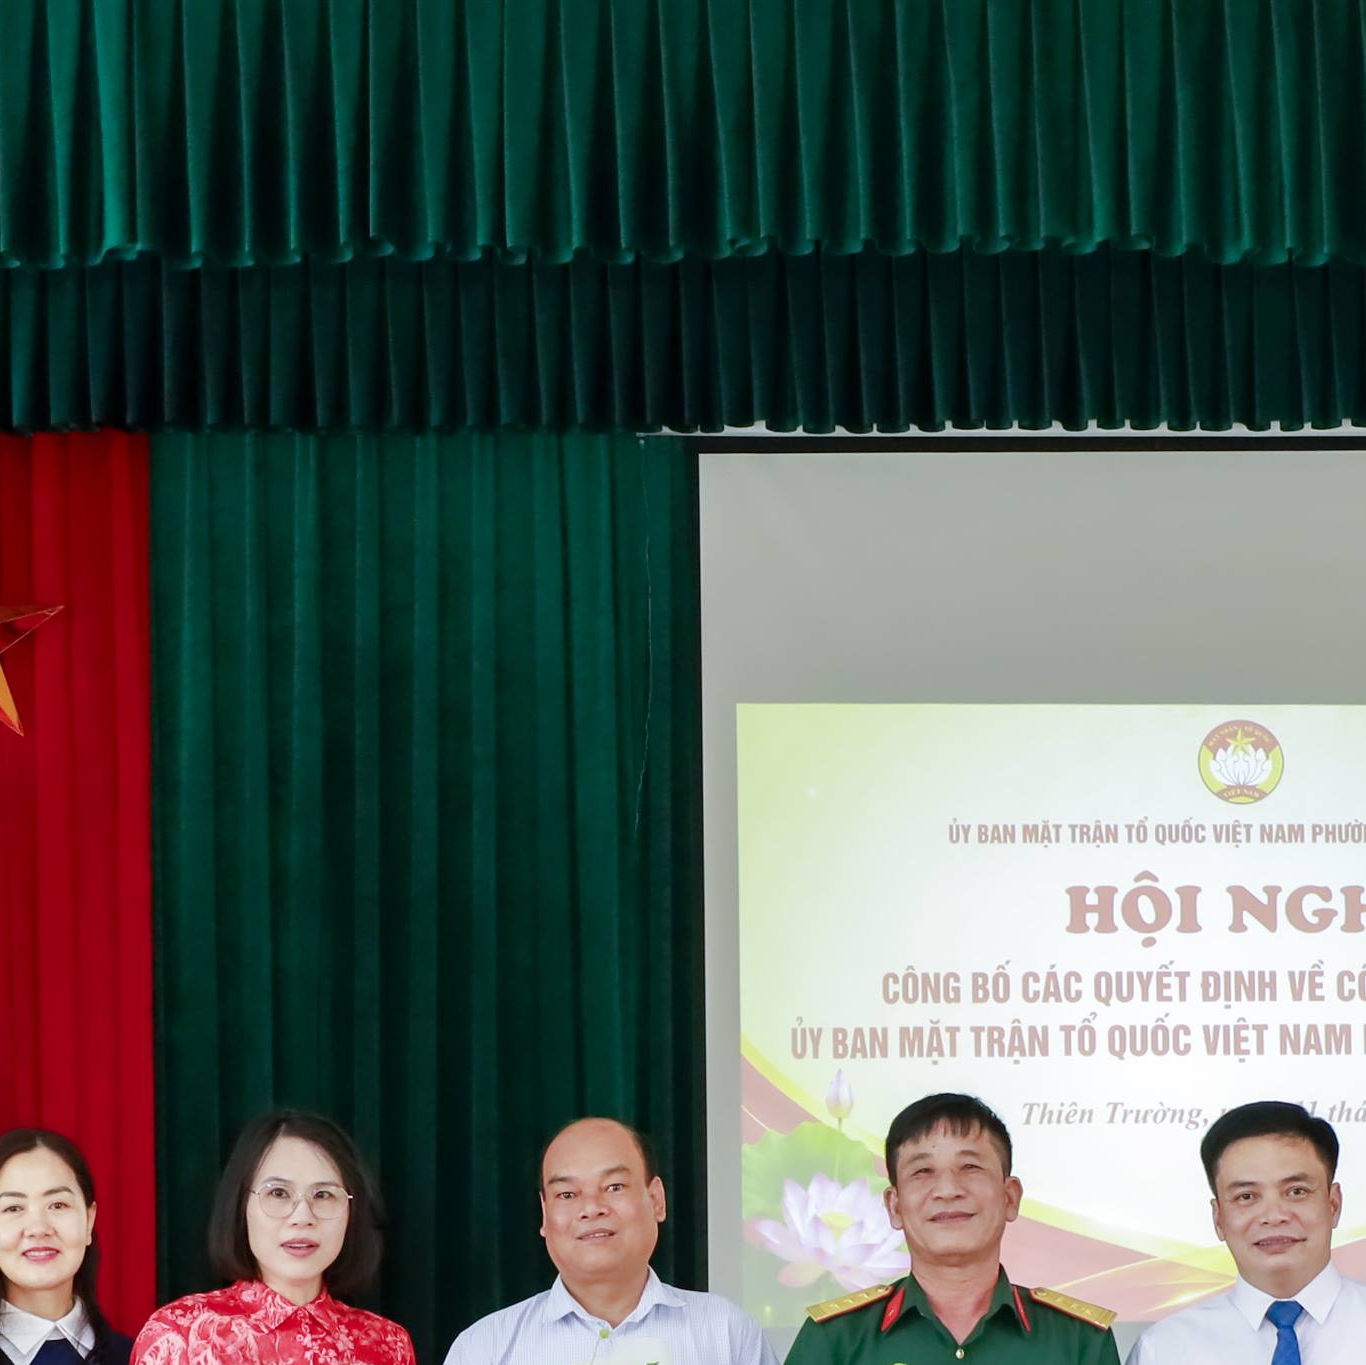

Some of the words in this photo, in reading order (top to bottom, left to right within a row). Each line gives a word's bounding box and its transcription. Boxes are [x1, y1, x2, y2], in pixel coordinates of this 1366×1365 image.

[947, 817, 972, 845] ỦY
[977, 822, 1017, 845] BAN
[1022, 819, 1063, 848] MẶT
[1068, 819, 1119, 848] TRẬN
[1125, 815, 1149, 845] TỔ
[1154, 816, 1207, 846] QUỐC
[1212, 818, 1254, 848] VIỆT
[1259, 822, 1305, 844] NAM
[1065, 869, 1203, 949] HỘI
[881, 965, 961, 1005] CÔNG
[971, 960, 1011, 1006] BỐ
[1021, 964, 1083, 1004] CÁC
[1094, 960, 1191, 1007] QUYẾT
[1200, 970, 1277, 1010] ĐỊNH
[1287, 959, 1325, 1002] VỀ
[791, 1016, 823, 1060] ỦY
[832, 1026, 889, 1060] BAN
[899, 1018, 961, 1066] MẶT
[969, 1018, 1049, 1065] TRẬN
[1059, 1011, 1098, 1057] TỔ
[1108, 1012, 1191, 1061] QUỐC
[1202, 1017, 1269, 1063] VIỆT
[1279, 1023, 1352, 1056] NAM
[1022, 1101, 1094, 1126] Thiên
[1107, 1101, 1209, 1130] Trường,
